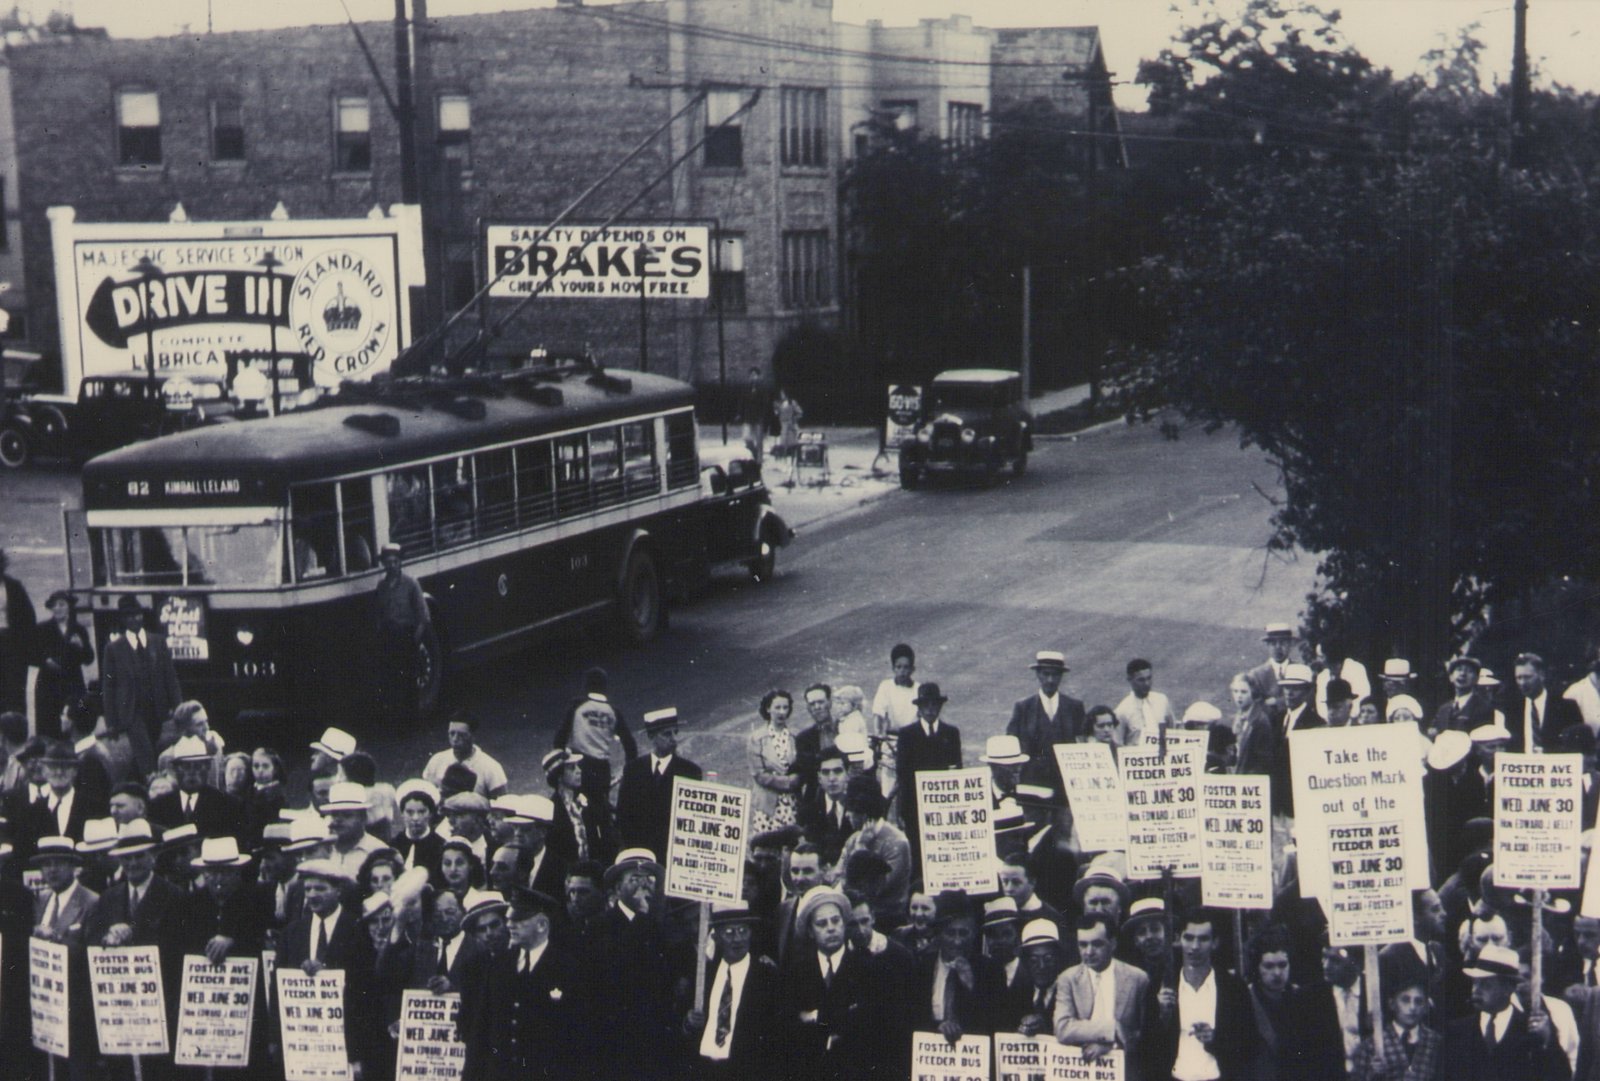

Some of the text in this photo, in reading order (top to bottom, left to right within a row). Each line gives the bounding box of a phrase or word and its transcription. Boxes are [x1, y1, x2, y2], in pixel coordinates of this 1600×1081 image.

[510, 229, 686, 243] SAFETY DEPENDS ON
[177, 248, 235, 265] SERVICE
[494, 245, 703, 278] BRAKES
[298, 254, 384, 300] STANDARD
[560, 281, 605, 293] YOURS
[649, 281, 690, 294] FREE
[112, 274, 229, 328] DRIVE
[160, 335, 246, 346] COMPLETE
[298, 322, 386, 374] RED CROWN
[1124, 755, 1165, 767] FOSTER
[1324, 747, 1388, 765] Take the
[1126, 767, 1192, 780] FEEDER BUS
[1501, 763, 1544, 774] FOSTER
[921, 779, 959, 791] FOSTER
[1308, 770, 1406, 790] Question Mark
[1502, 777, 1572, 788] FEEDER BUS
[678, 787, 717, 802] FOSTER
[923, 791, 984, 803] FEEDER BUS
[1150, 788, 1175, 804] JUNE
[1177, 786, 1195, 802] 30
[678, 799, 740, 818] FEEDER BUS
[1322, 796, 1396, 813] out of the
[1527, 797, 1552, 812] JUNE
[1556, 797, 1573, 812] 30
[945, 810, 968, 825] JUNE
[970, 809, 987, 823] 30
[698, 820, 721, 837] JUNE
[724, 824, 740, 840] 30
[1330, 827, 1372, 839] FOSTER
[1332, 838, 1400, 851] FEEDER BUS
[1357, 858, 1382, 873] JUNE
[1385, 856, 1402, 871] 30
[408, 998, 446, 1009] FOSTER
[408, 1010, 444, 1020] FEEDER
[428, 1028, 450, 1042] JUNE
[1000, 1042, 1040, 1053] FOSTER
[919, 1055, 982, 1068] FEEDER BUS
[1002, 1055, 1040, 1067] FEEDER
[1053, 1067, 1090, 1080] FEEDER
[1095, 1070, 1116, 1081] BUS
